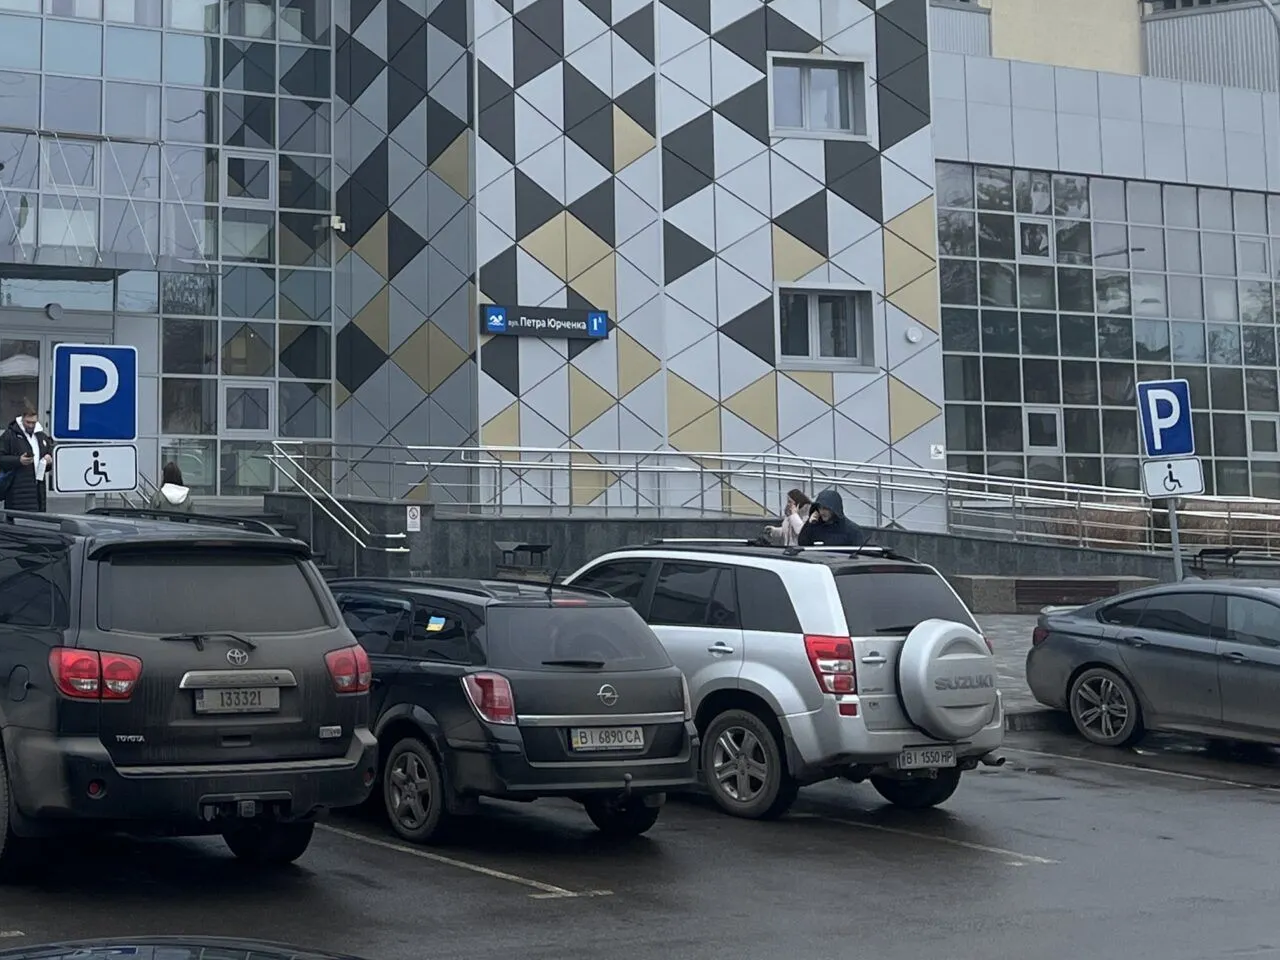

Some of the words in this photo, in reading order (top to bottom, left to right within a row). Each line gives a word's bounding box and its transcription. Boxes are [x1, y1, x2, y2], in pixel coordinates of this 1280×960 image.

[520, 316, 546, 329] Петра
[548, 318, 587, 330] Юрченка
[68, 354, 119, 430] P
[1147, 389, 1180, 450] P
[934, 675, 993, 691] SUZUKI
[115, 734, 145, 742] TOYOTA
[579, 731, 594, 745] BI
[598, 730, 624, 744] 6890
[624, 729, 642, 744] CA
[920, 751, 940, 764] 1550
